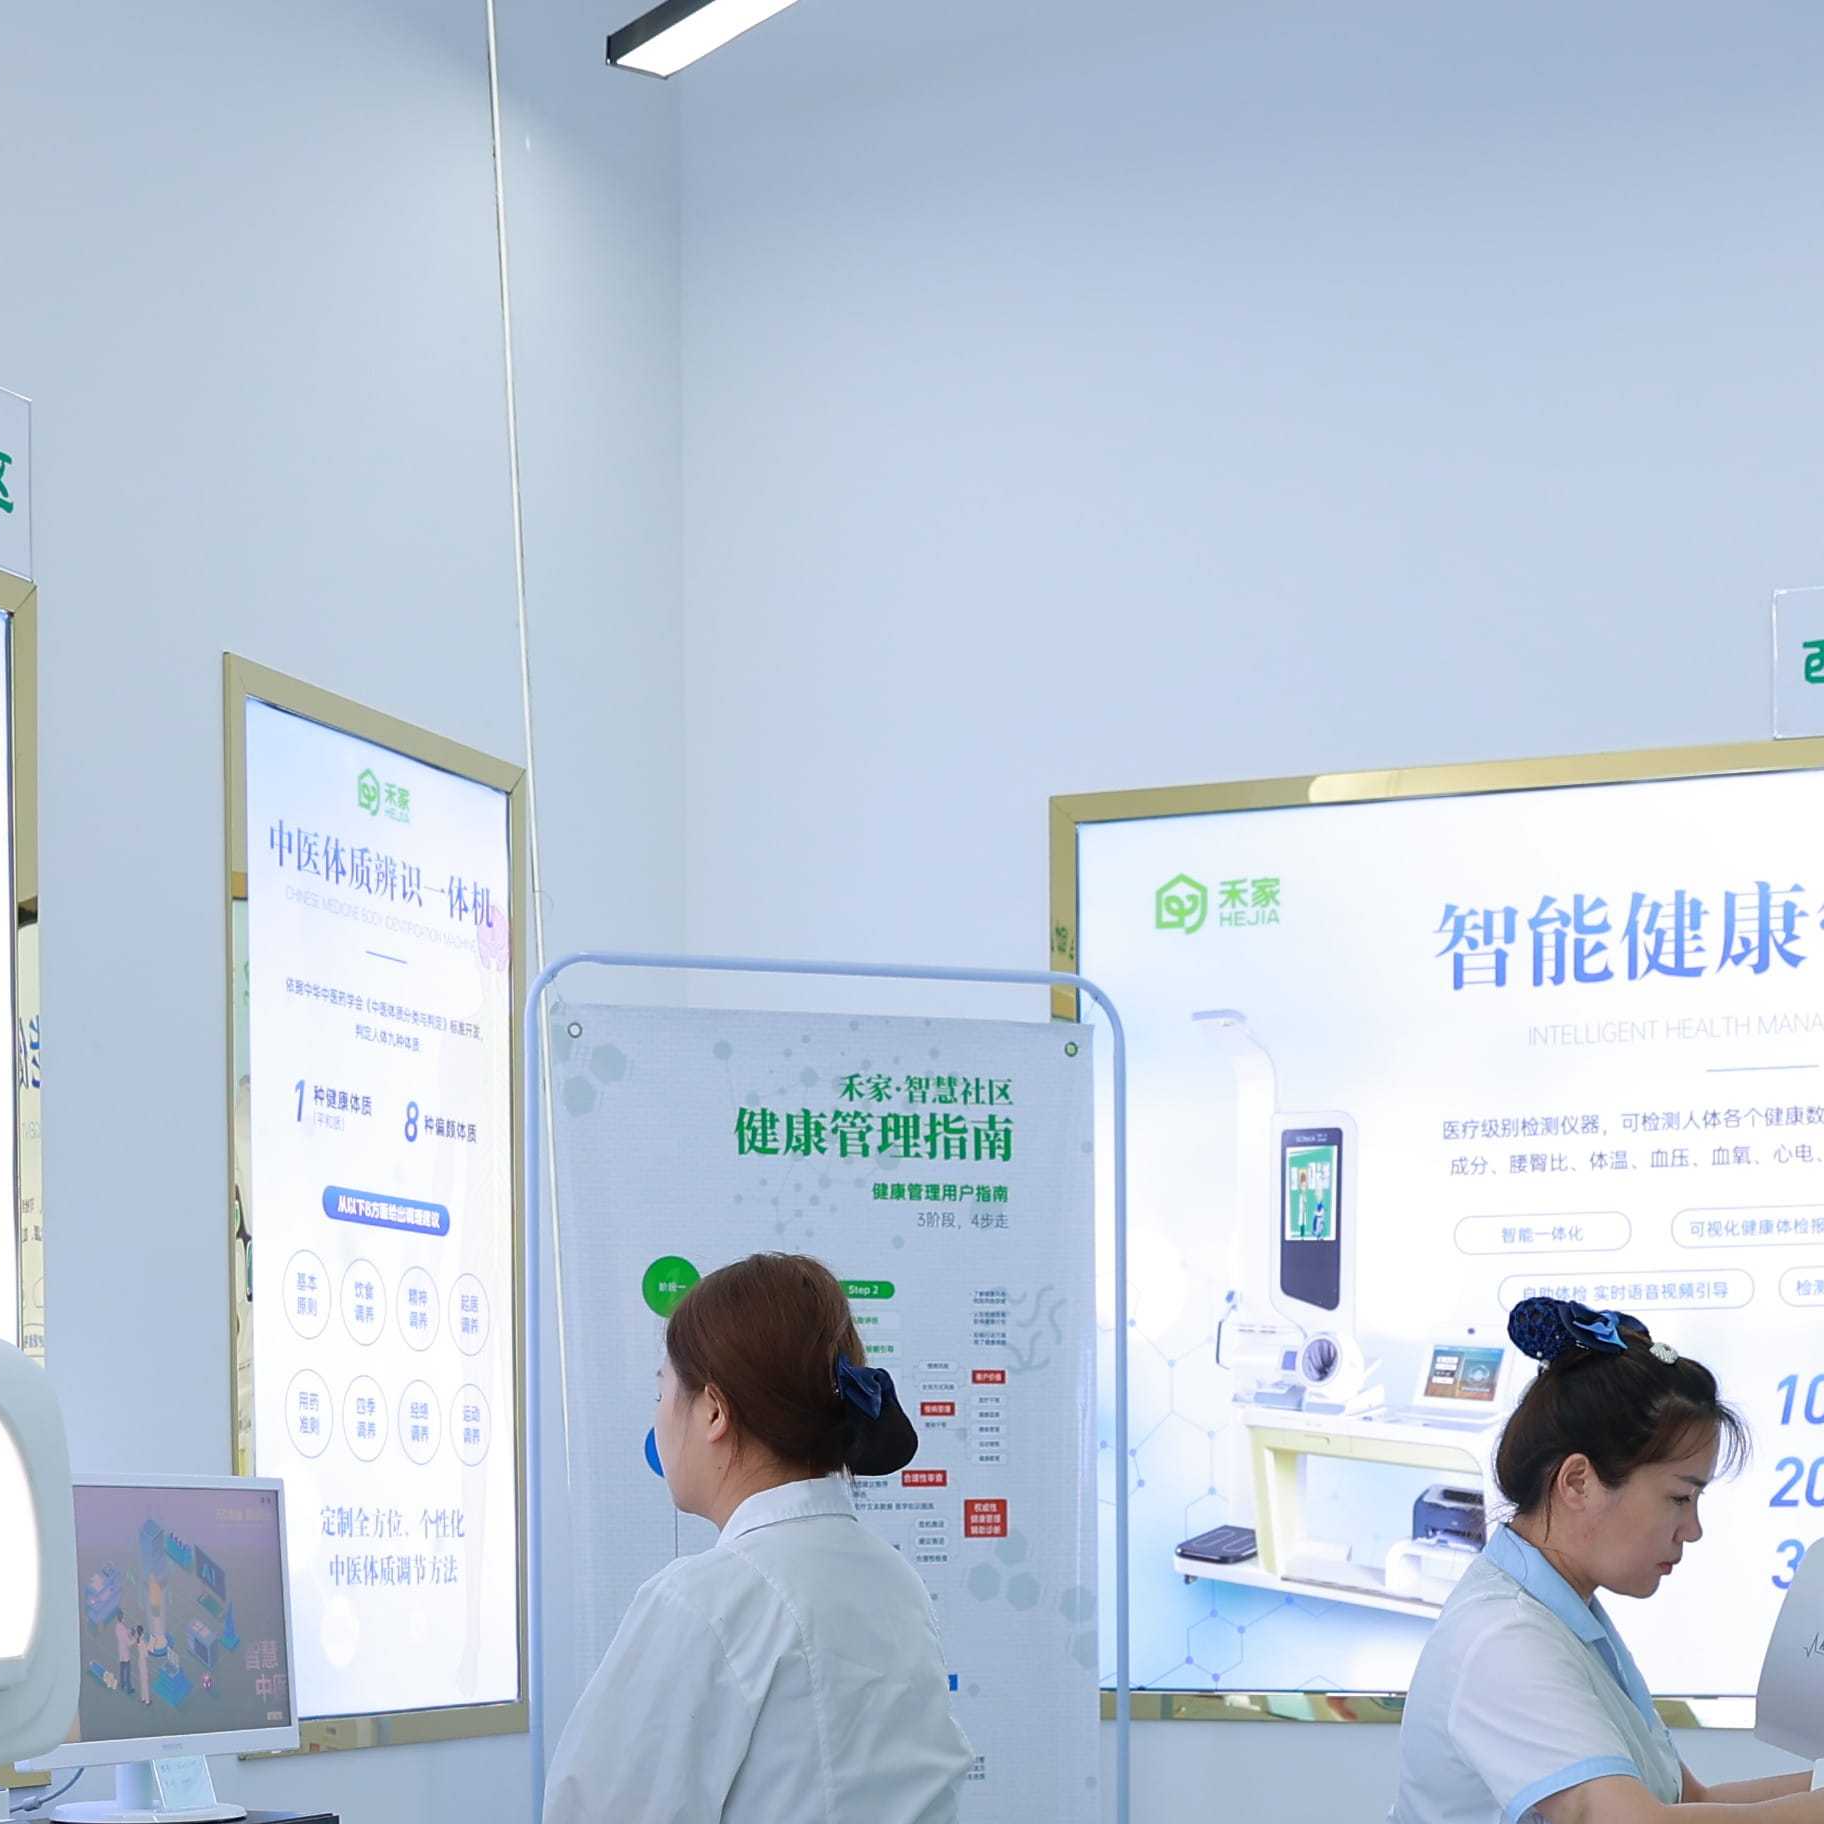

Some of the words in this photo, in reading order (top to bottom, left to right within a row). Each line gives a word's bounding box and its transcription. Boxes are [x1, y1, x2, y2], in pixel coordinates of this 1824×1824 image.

[269, 818, 495, 929] 中医体质辨识一体机
[1218, 876, 1281, 909] 禾家
[1218, 911, 1280, 927] HEJIA
[1527, 1019, 1660, 1047] INTELLIGENT
[1666, 1014, 1752, 1040] HEALTH
[295, 1079, 306, 1122] 1
[313, 1085, 373, 1117] 种健康体质
[839, 1072, 1014, 1106] 禾家·智慧社区
[404, 1101, 419, 1142] 8
[424, 1115, 478, 1144] 种偏颇体质
[734, 1106, 1014, 1163] 健康管理指南
[872, 1181, 1009, 1204] 健康管理用户指南
[1501, 1226, 1584, 1244] 智能一体化
[848, 1285, 871, 1296] Step
[873, 1285, 879, 1294] 2
[320, 1506, 466, 1540] 定制全方位、个性化
[329, 1554, 459, 1587] 中医体质调节方法
